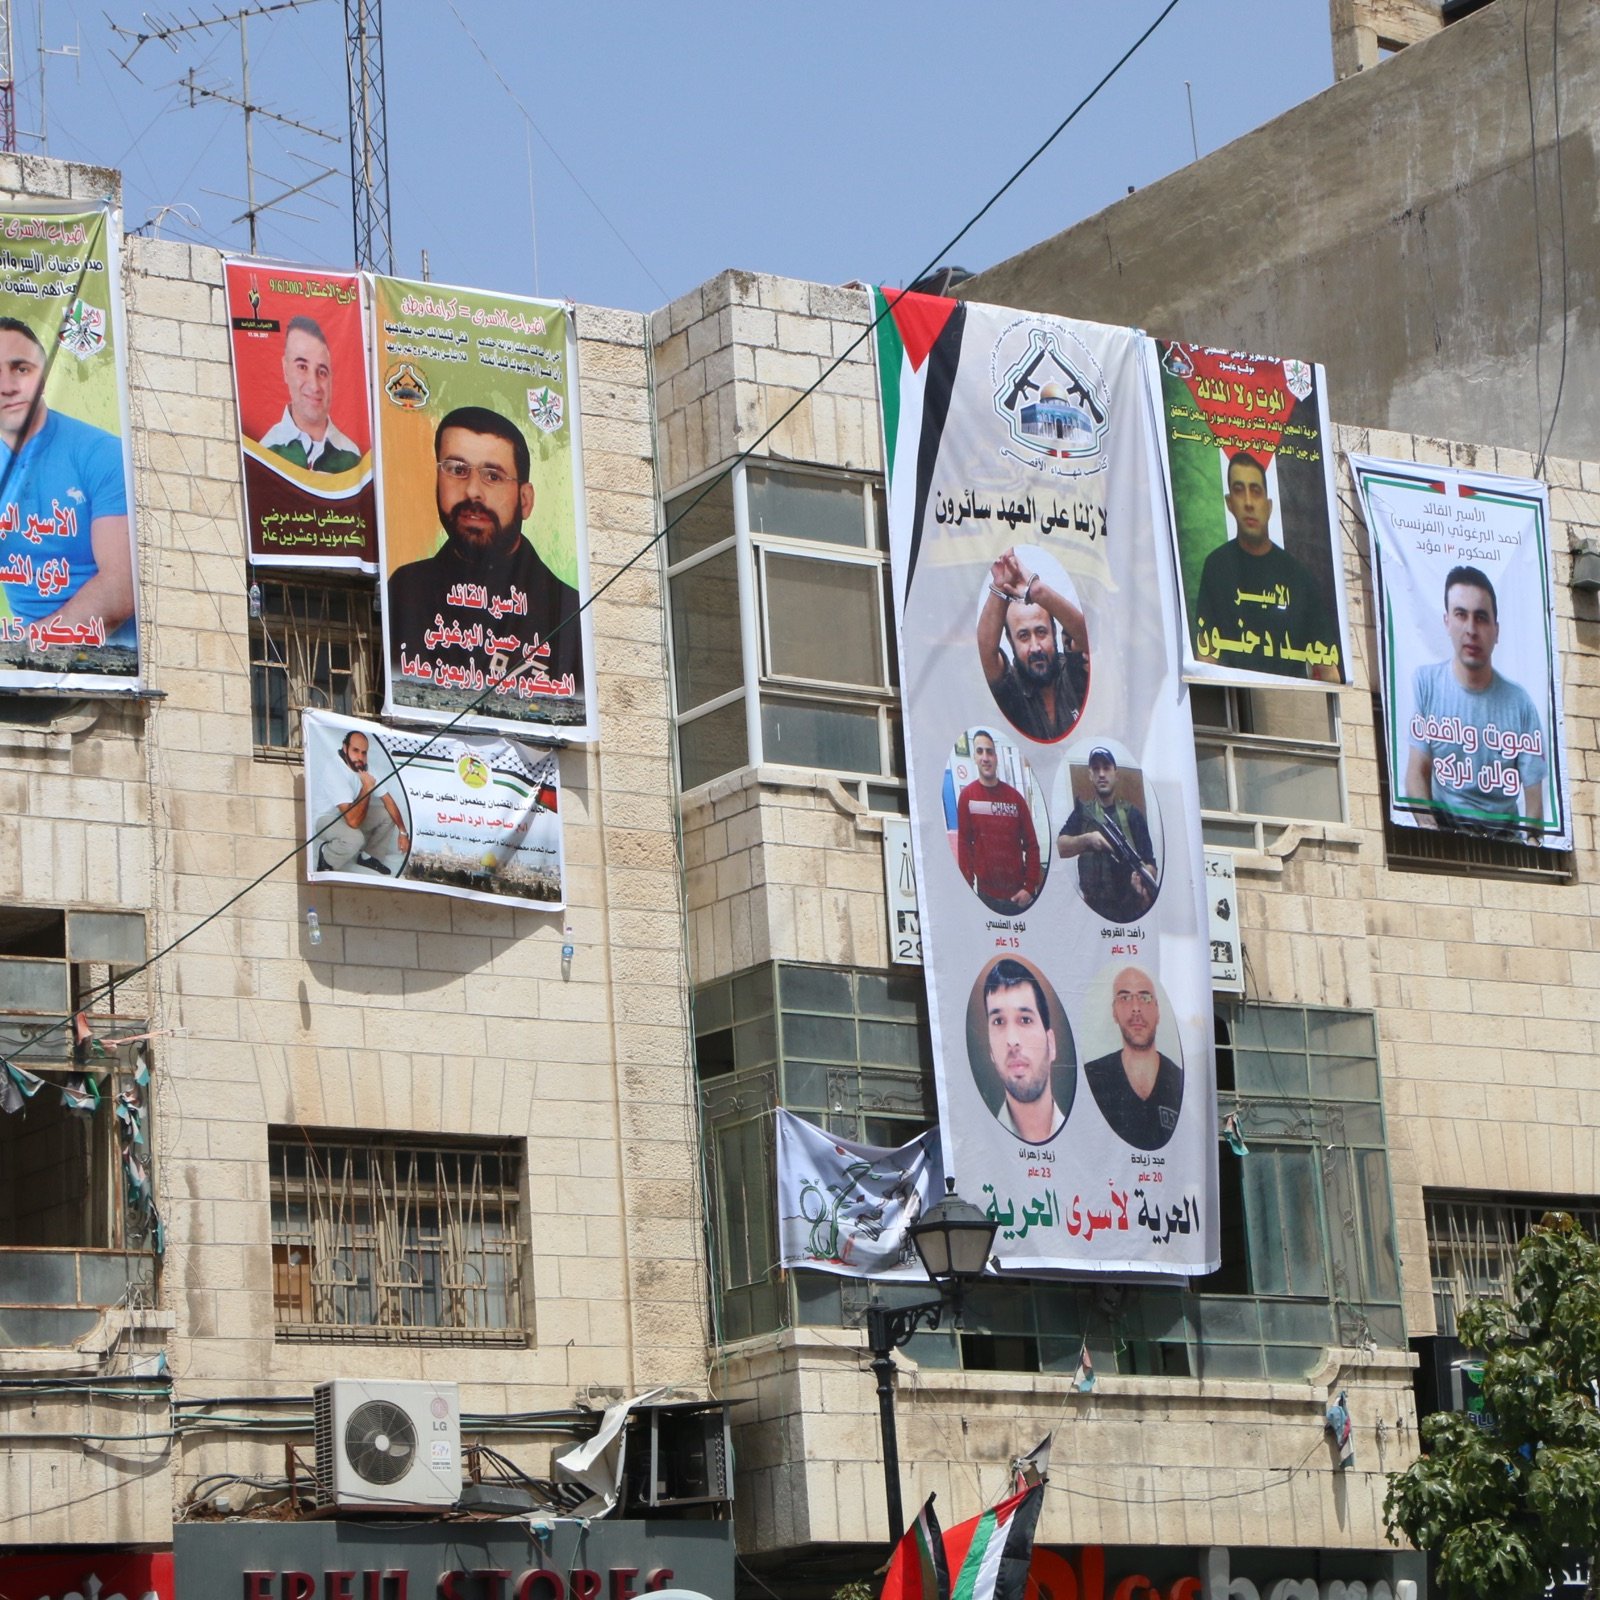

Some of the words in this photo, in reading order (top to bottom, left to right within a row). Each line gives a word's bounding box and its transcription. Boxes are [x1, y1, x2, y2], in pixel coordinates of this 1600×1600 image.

[1195, 376, 1231, 404] المذلة
[1233, 382, 1253, 411] ولا
[1256, 386, 1286, 414] الموت
[936, 489, 992, 525] سائرون
[996, 496, 1036, 530] العهد
[1041, 498, 1070, 534] على
[1424, 502, 1452, 518] القائد
[1456, 506, 1486, 522] الأسير
[22, 499, 77, 544] الأسير
[1448, 524, 1494, 542] البرغوثي
[262, 528, 278, 545] عام
[280, 528, 317, 546] وعشرين
[1458, 546, 1500, 561] المحكوم
[36, 558, 70, 597] لؤي
[446, 584, 488, 610] القائد
[488, 585, 528, 619] الأسير
[29, 615, 106, 652] المحكوم
[424, 614, 483, 651] البرغوثي
[484, 628, 520, 655] حسن
[523, 632, 550, 663] علي
[1280, 630, 1339, 666] محمد
[518, 672, 575, 698] المحكوم
[1483, 724, 1542, 758] نموت
[1434, 754, 1474, 788] نركع
[1478, 761, 1519, 795] ولن
[996, 936, 1007, 947] عام
[1010, 937, 1020, 948] 15
[1112, 944, 1124, 956] عام
[1127, 944, 1138, 955] 15
[1028, 1167, 1040, 1178] عام
[1041, 1168, 1051, 1178] 23
[1138, 1172, 1150, 1182] عام
[1153, 1172, 1162, 1182] 20
[982, 1183, 1060, 1240] الحرية
[1066, 1178, 1128, 1242] لأسرى
[1134, 1188, 1200, 1244] الحرية
[432, 1421, 448, 1431] LG
